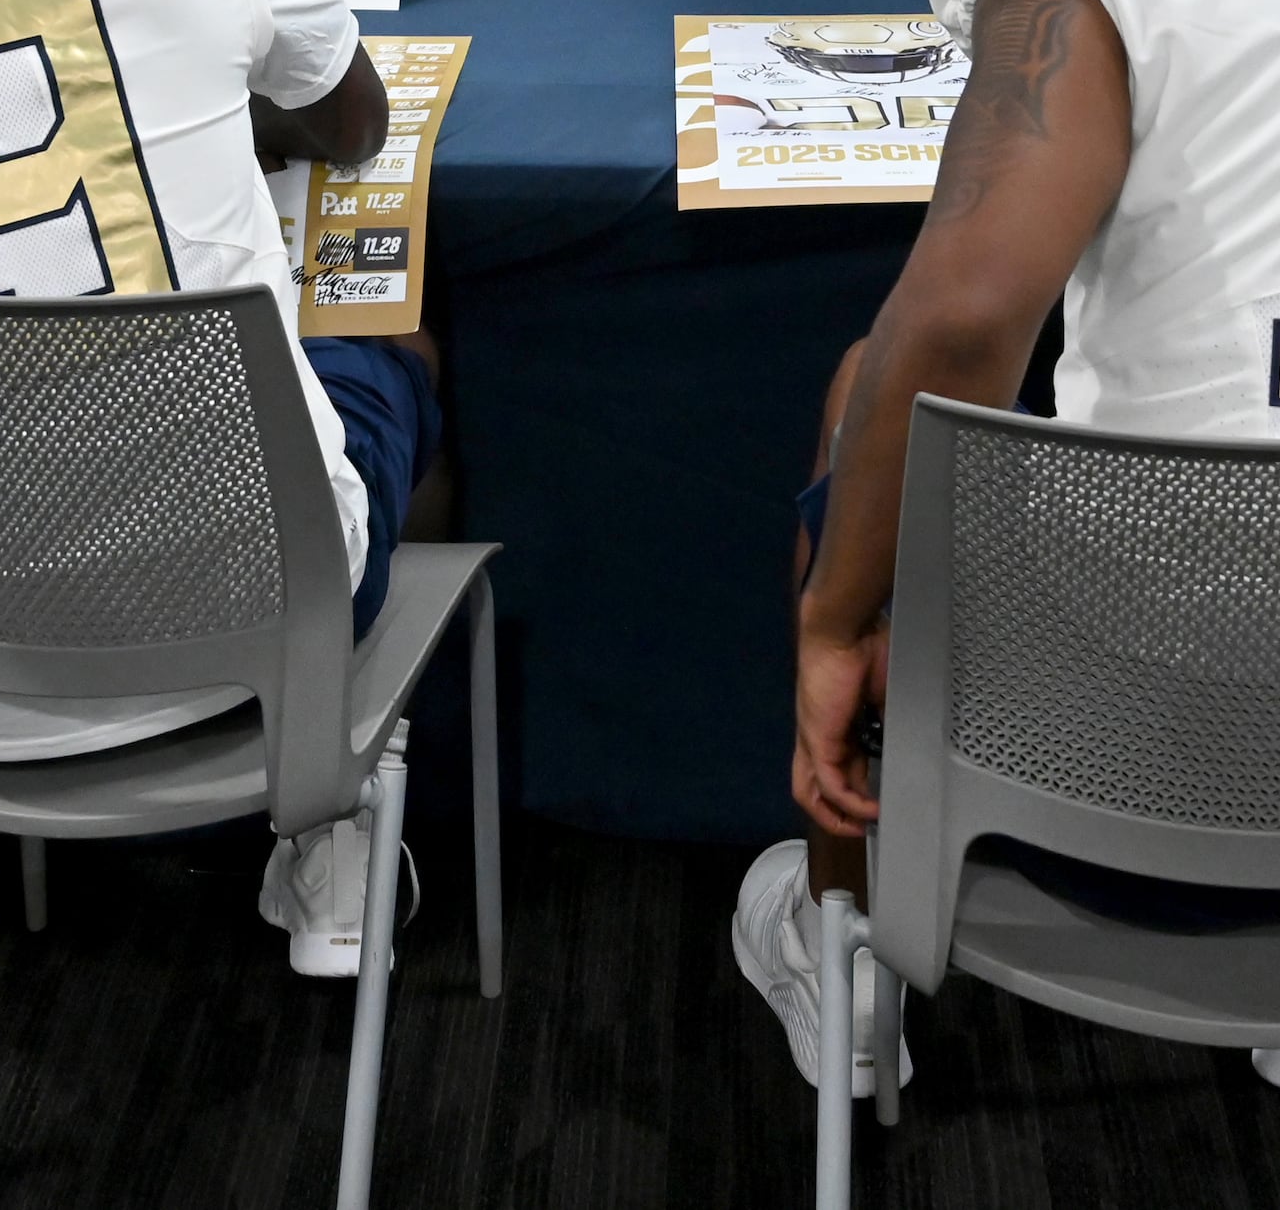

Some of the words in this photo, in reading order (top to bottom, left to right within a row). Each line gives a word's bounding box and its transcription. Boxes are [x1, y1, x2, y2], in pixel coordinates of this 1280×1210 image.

[372, 157, 407, 170] 11.15
[737, 145, 846, 167] 2025
[321, 192, 357, 216] Pitt
[366, 192, 405, 209] 11.22
[362, 236, 402, 254] 11.28
